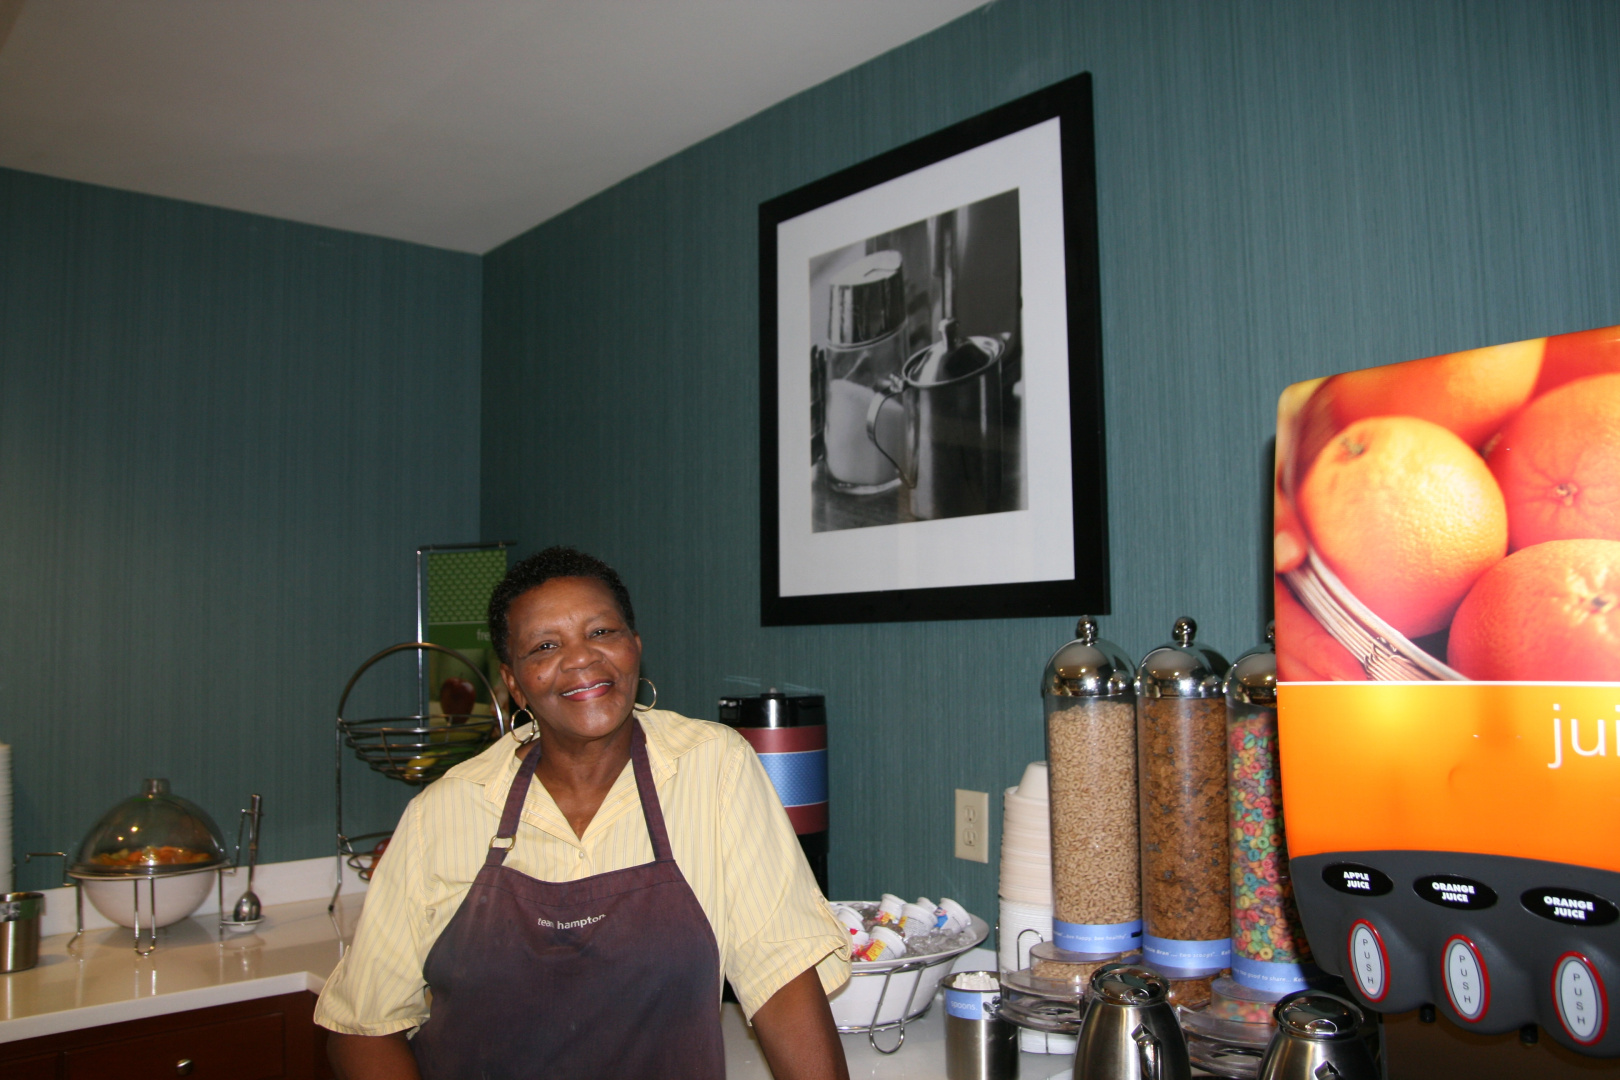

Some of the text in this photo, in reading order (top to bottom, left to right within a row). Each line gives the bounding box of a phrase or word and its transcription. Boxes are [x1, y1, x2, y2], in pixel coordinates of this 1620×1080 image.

[1343, 871, 1370, 881] APPLE
[1346, 880, 1371, 890] JUICE
[1431, 881, 1475, 894] ORANGE
[1441, 891, 1469, 903] JUICE
[1543, 895, 1594, 912] ORANGE
[1553, 906, 1585, 920] JUICE
[1362, 938, 1374, 985] PUSH
[1459, 954, 1472, 1004] PUSH
[1573, 972, 1586, 1025] PUSH
